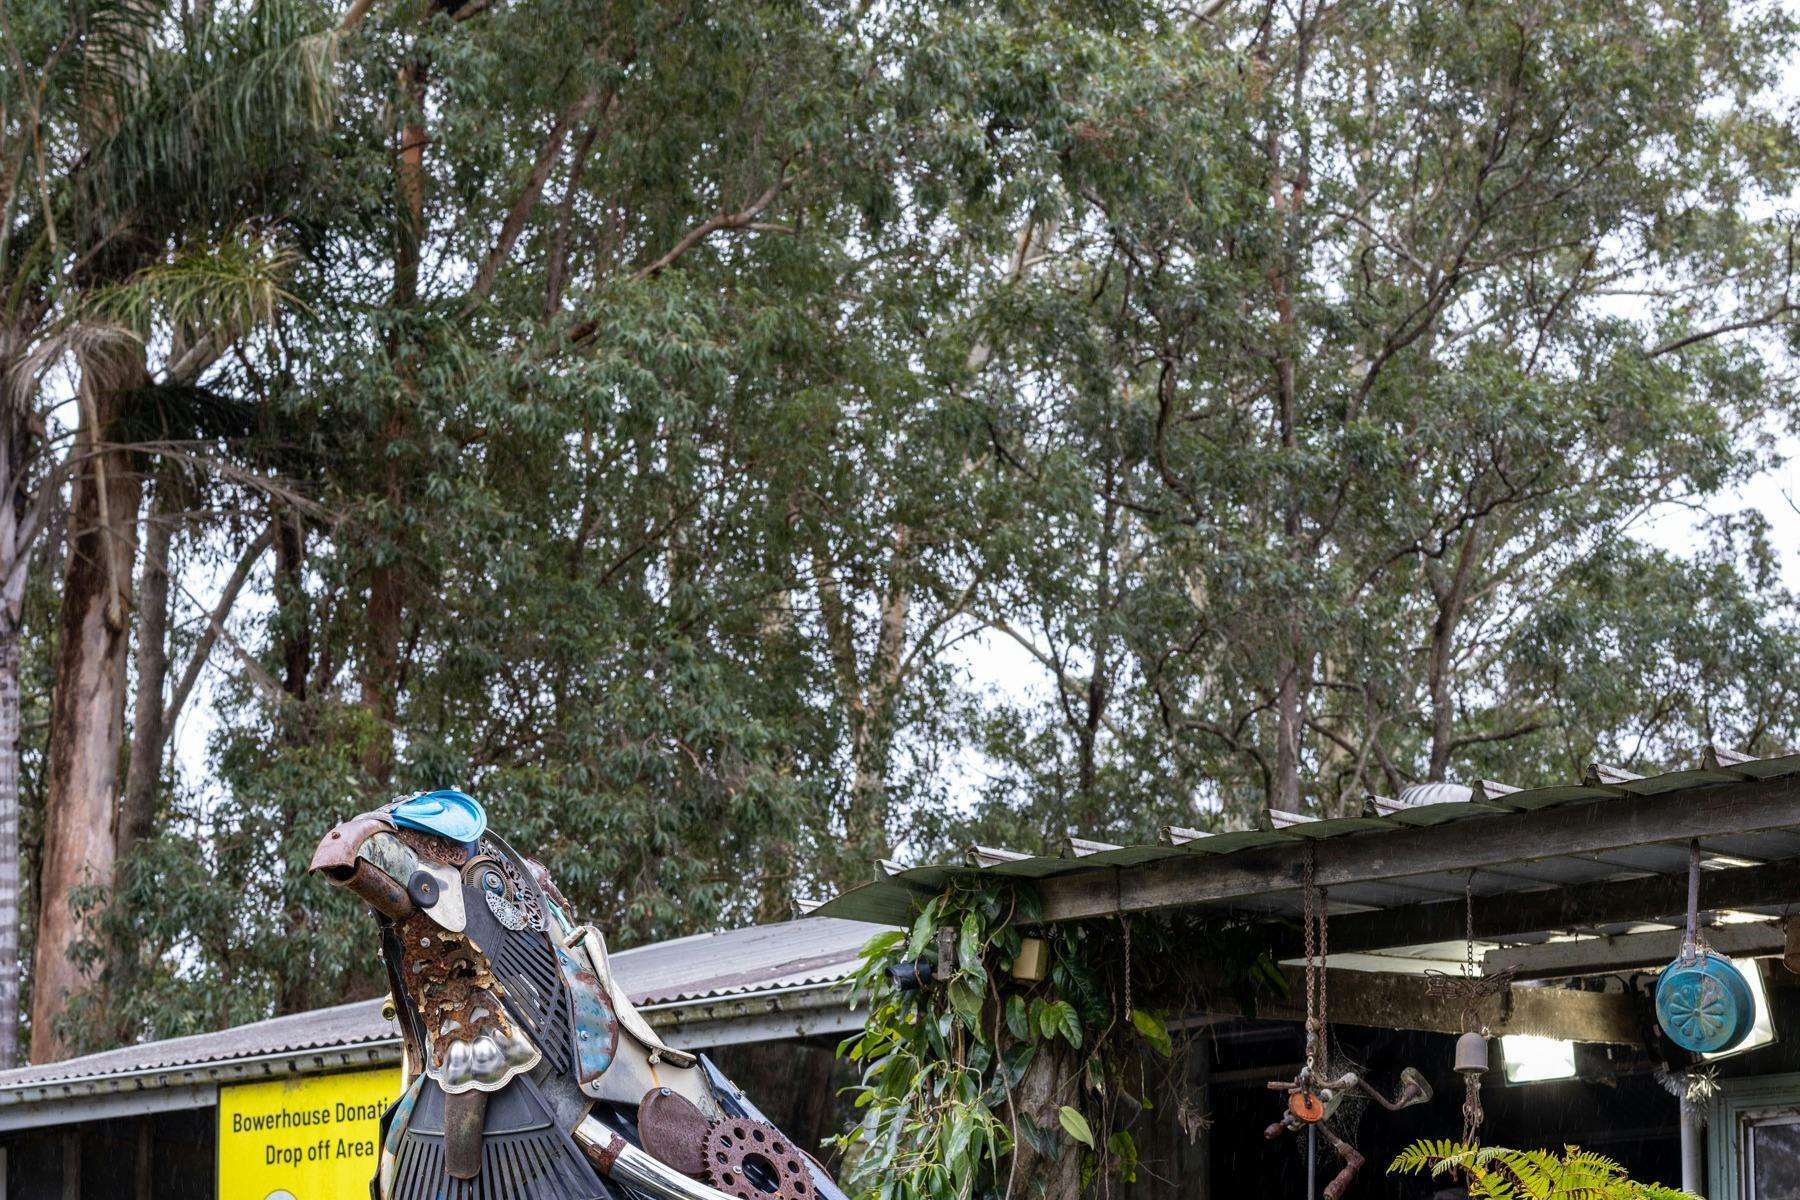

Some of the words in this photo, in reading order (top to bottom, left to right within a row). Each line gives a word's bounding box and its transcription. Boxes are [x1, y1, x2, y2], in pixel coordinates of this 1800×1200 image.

[233, 1108, 330, 1133] Bowerhouse
[266, 1145, 302, 1167] Drop
[308, 1139, 330, 1160] off
[336, 1138, 374, 1158] Area
